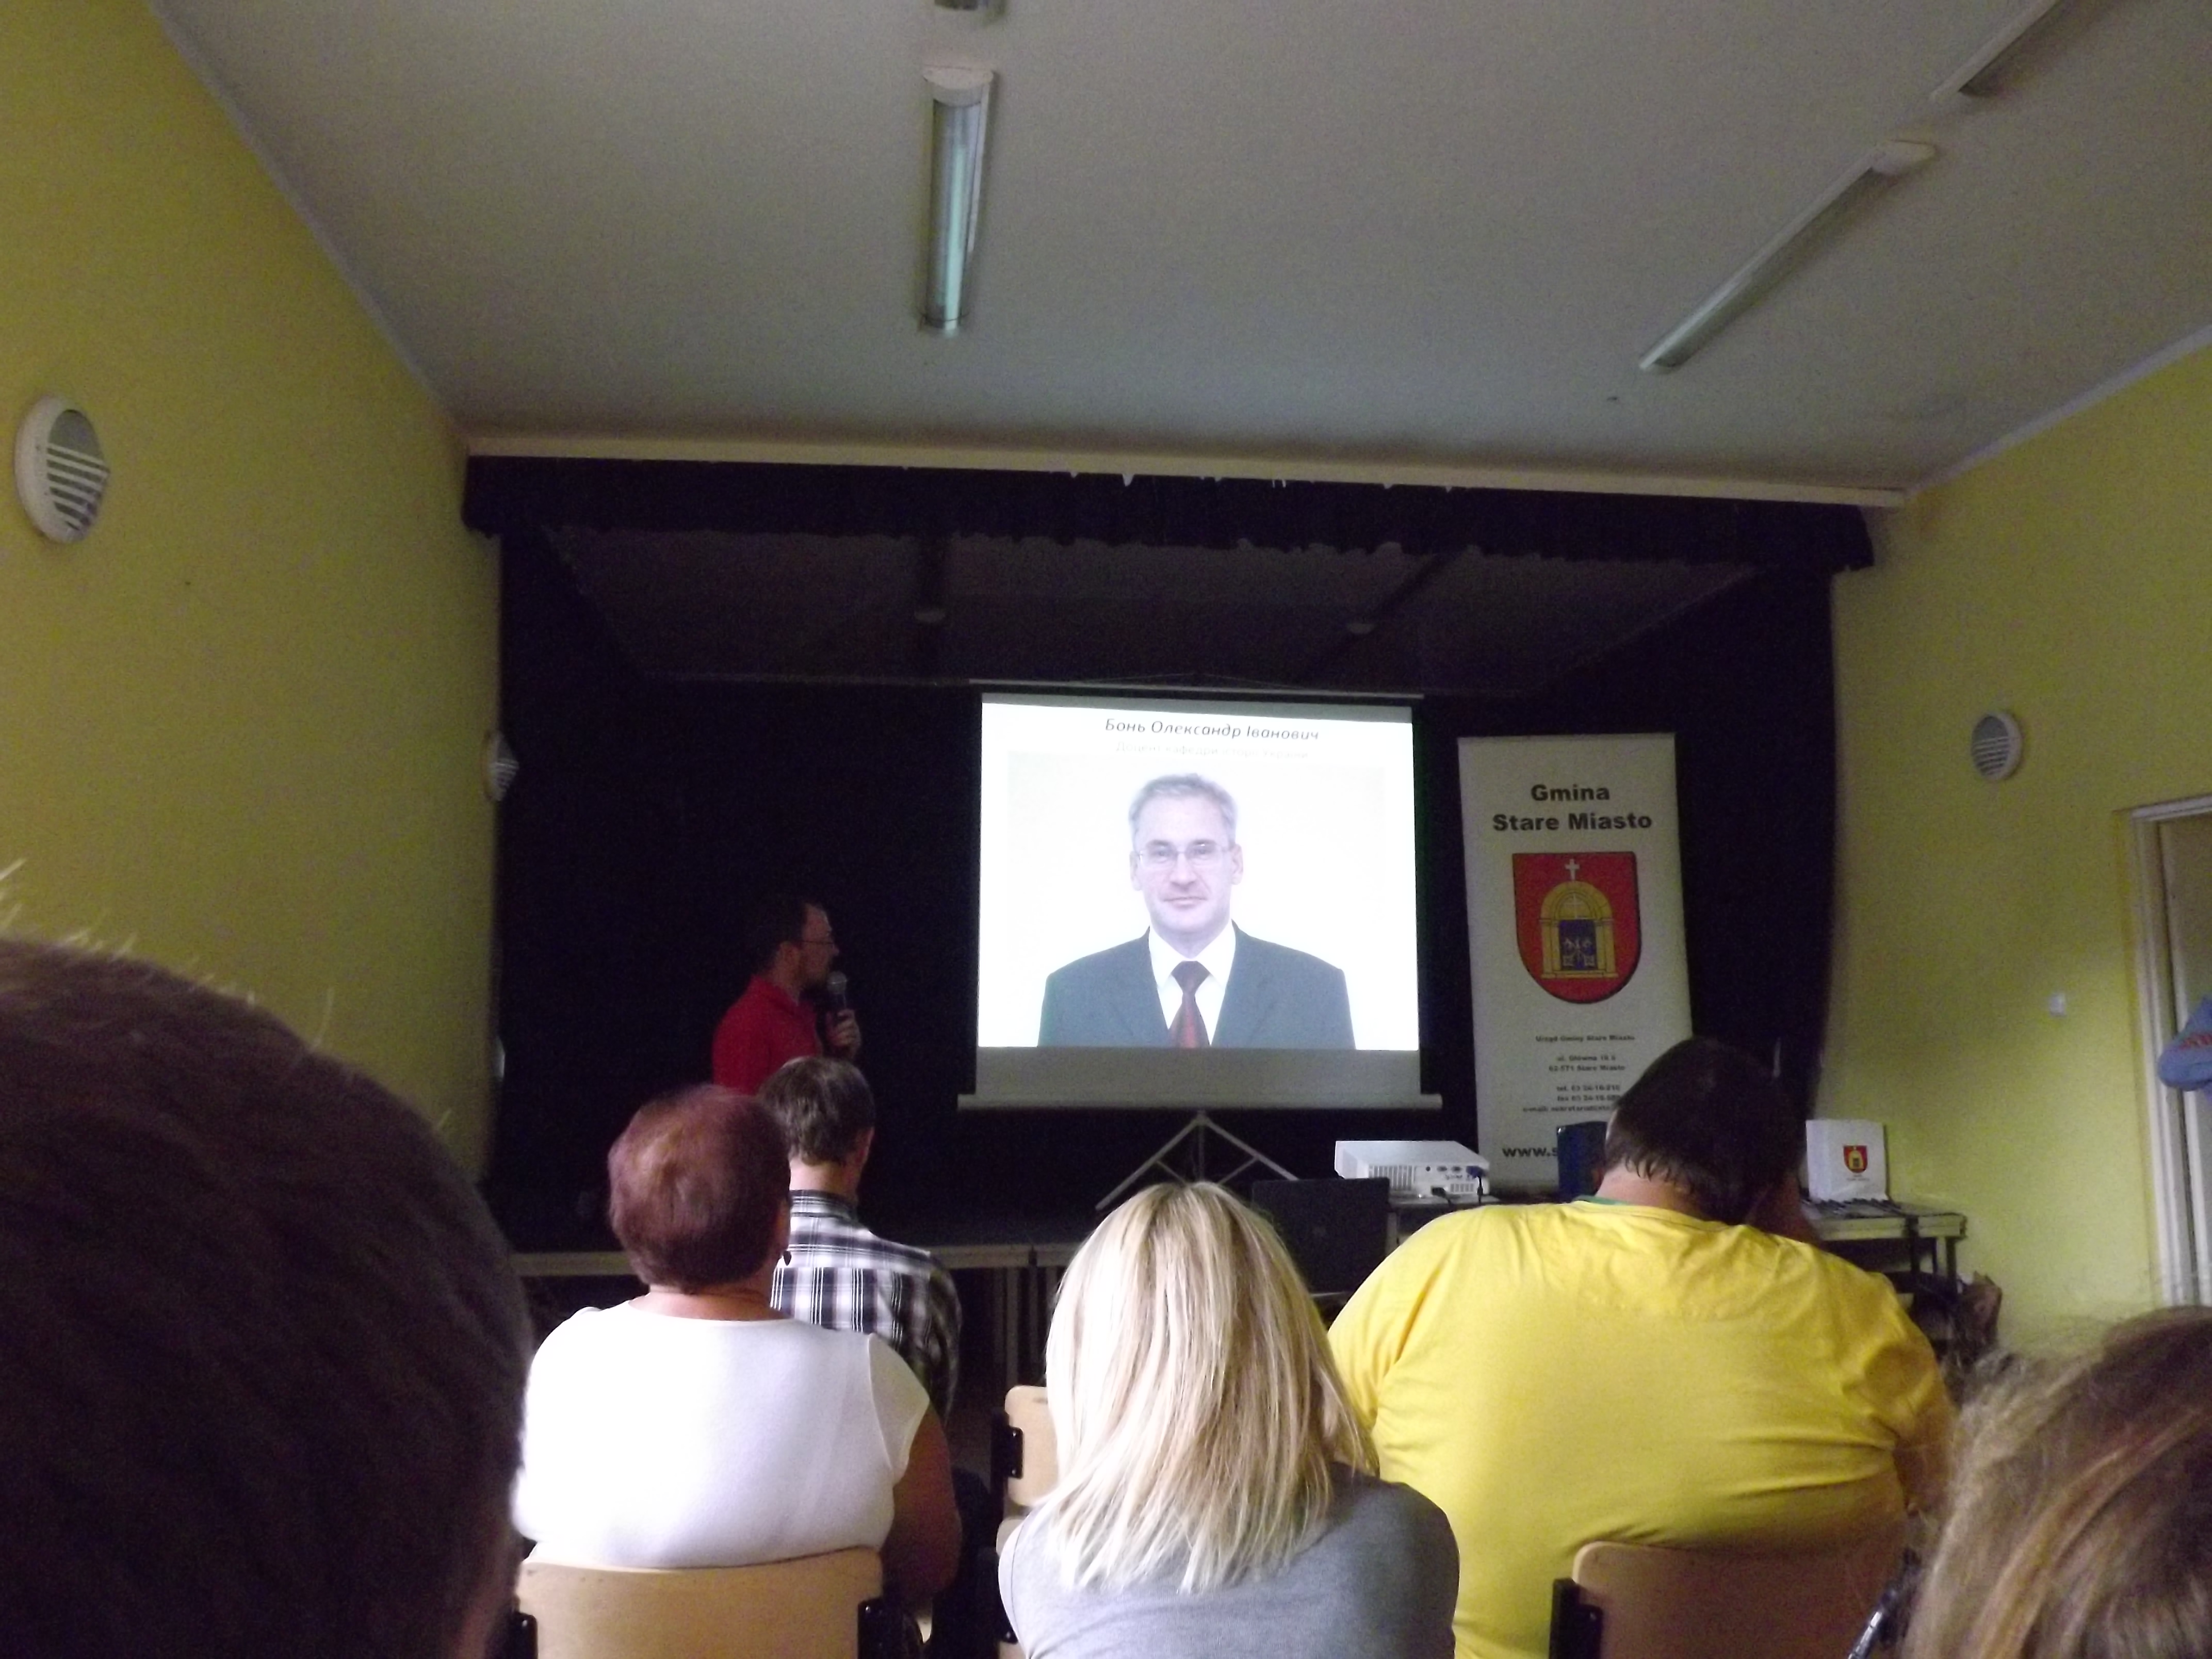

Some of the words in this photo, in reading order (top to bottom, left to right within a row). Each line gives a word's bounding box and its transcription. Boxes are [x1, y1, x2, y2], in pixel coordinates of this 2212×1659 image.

[1105, 718, 1145, 733] Бонь
[1151, 721, 1241, 739] Олександр
[1246, 725, 1320, 740] Іванович
[1531, 784, 1609, 801] Gmina
[1492, 814, 1559, 831] Stare
[1568, 812, 1652, 830] Miasto
